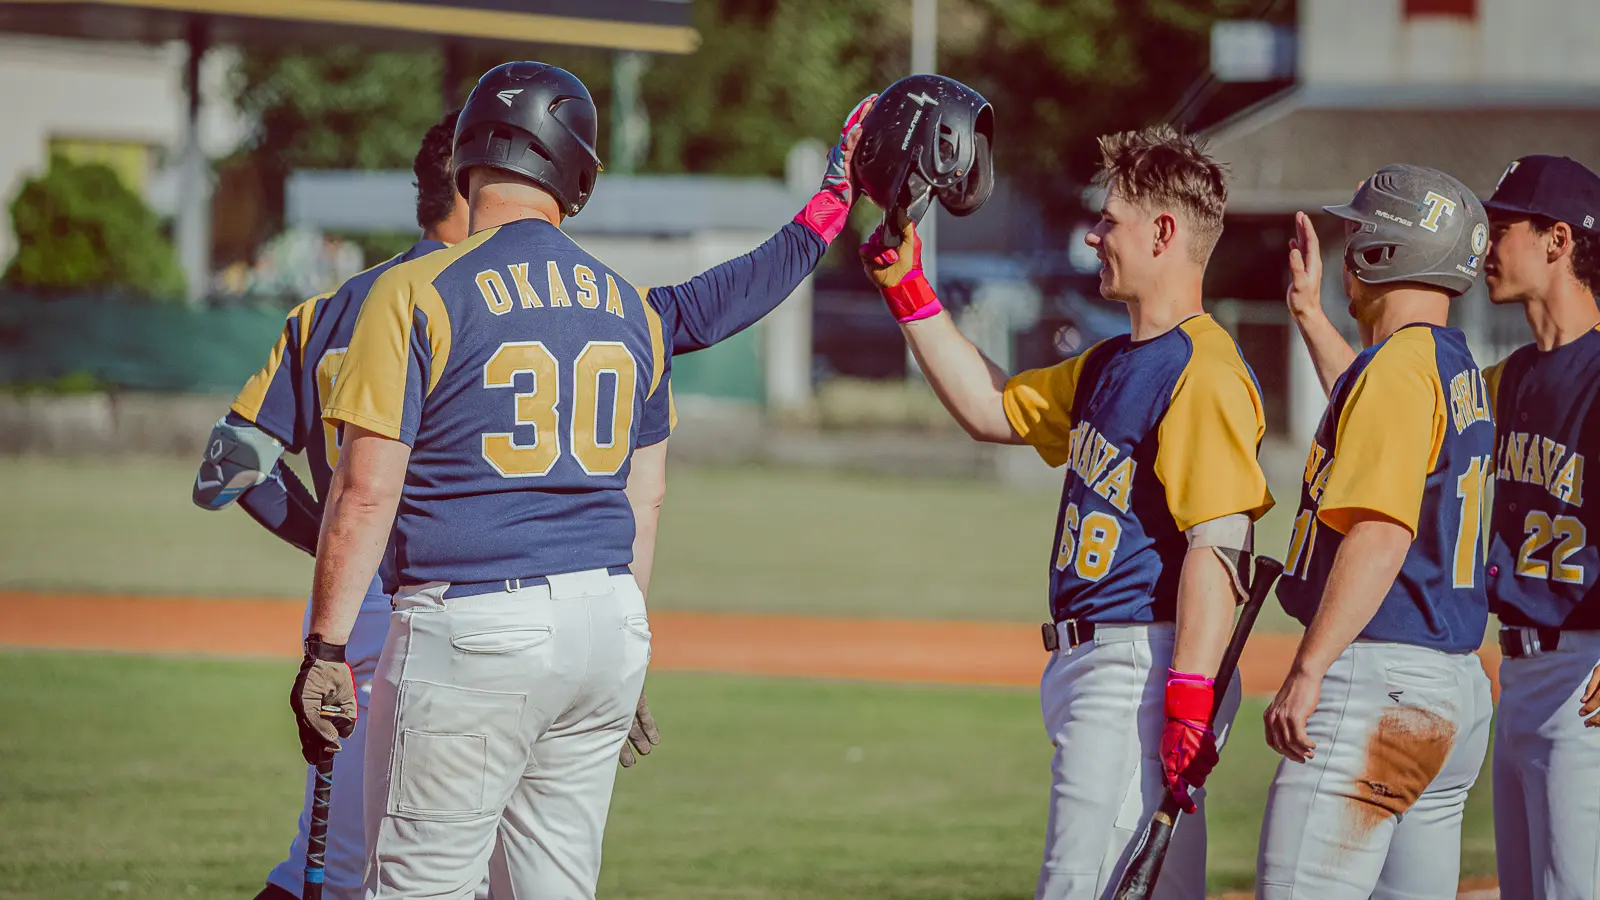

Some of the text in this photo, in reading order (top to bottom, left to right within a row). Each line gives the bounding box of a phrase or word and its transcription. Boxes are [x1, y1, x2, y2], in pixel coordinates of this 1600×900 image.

[1419, 190, 1457, 233] T
[475, 261, 625, 319] OKASA
[482, 340, 637, 478] 30
[1496, 431, 1585, 508] NAVA
[1056, 502, 1122, 582] 68
[1515, 510, 1586, 585] 22
